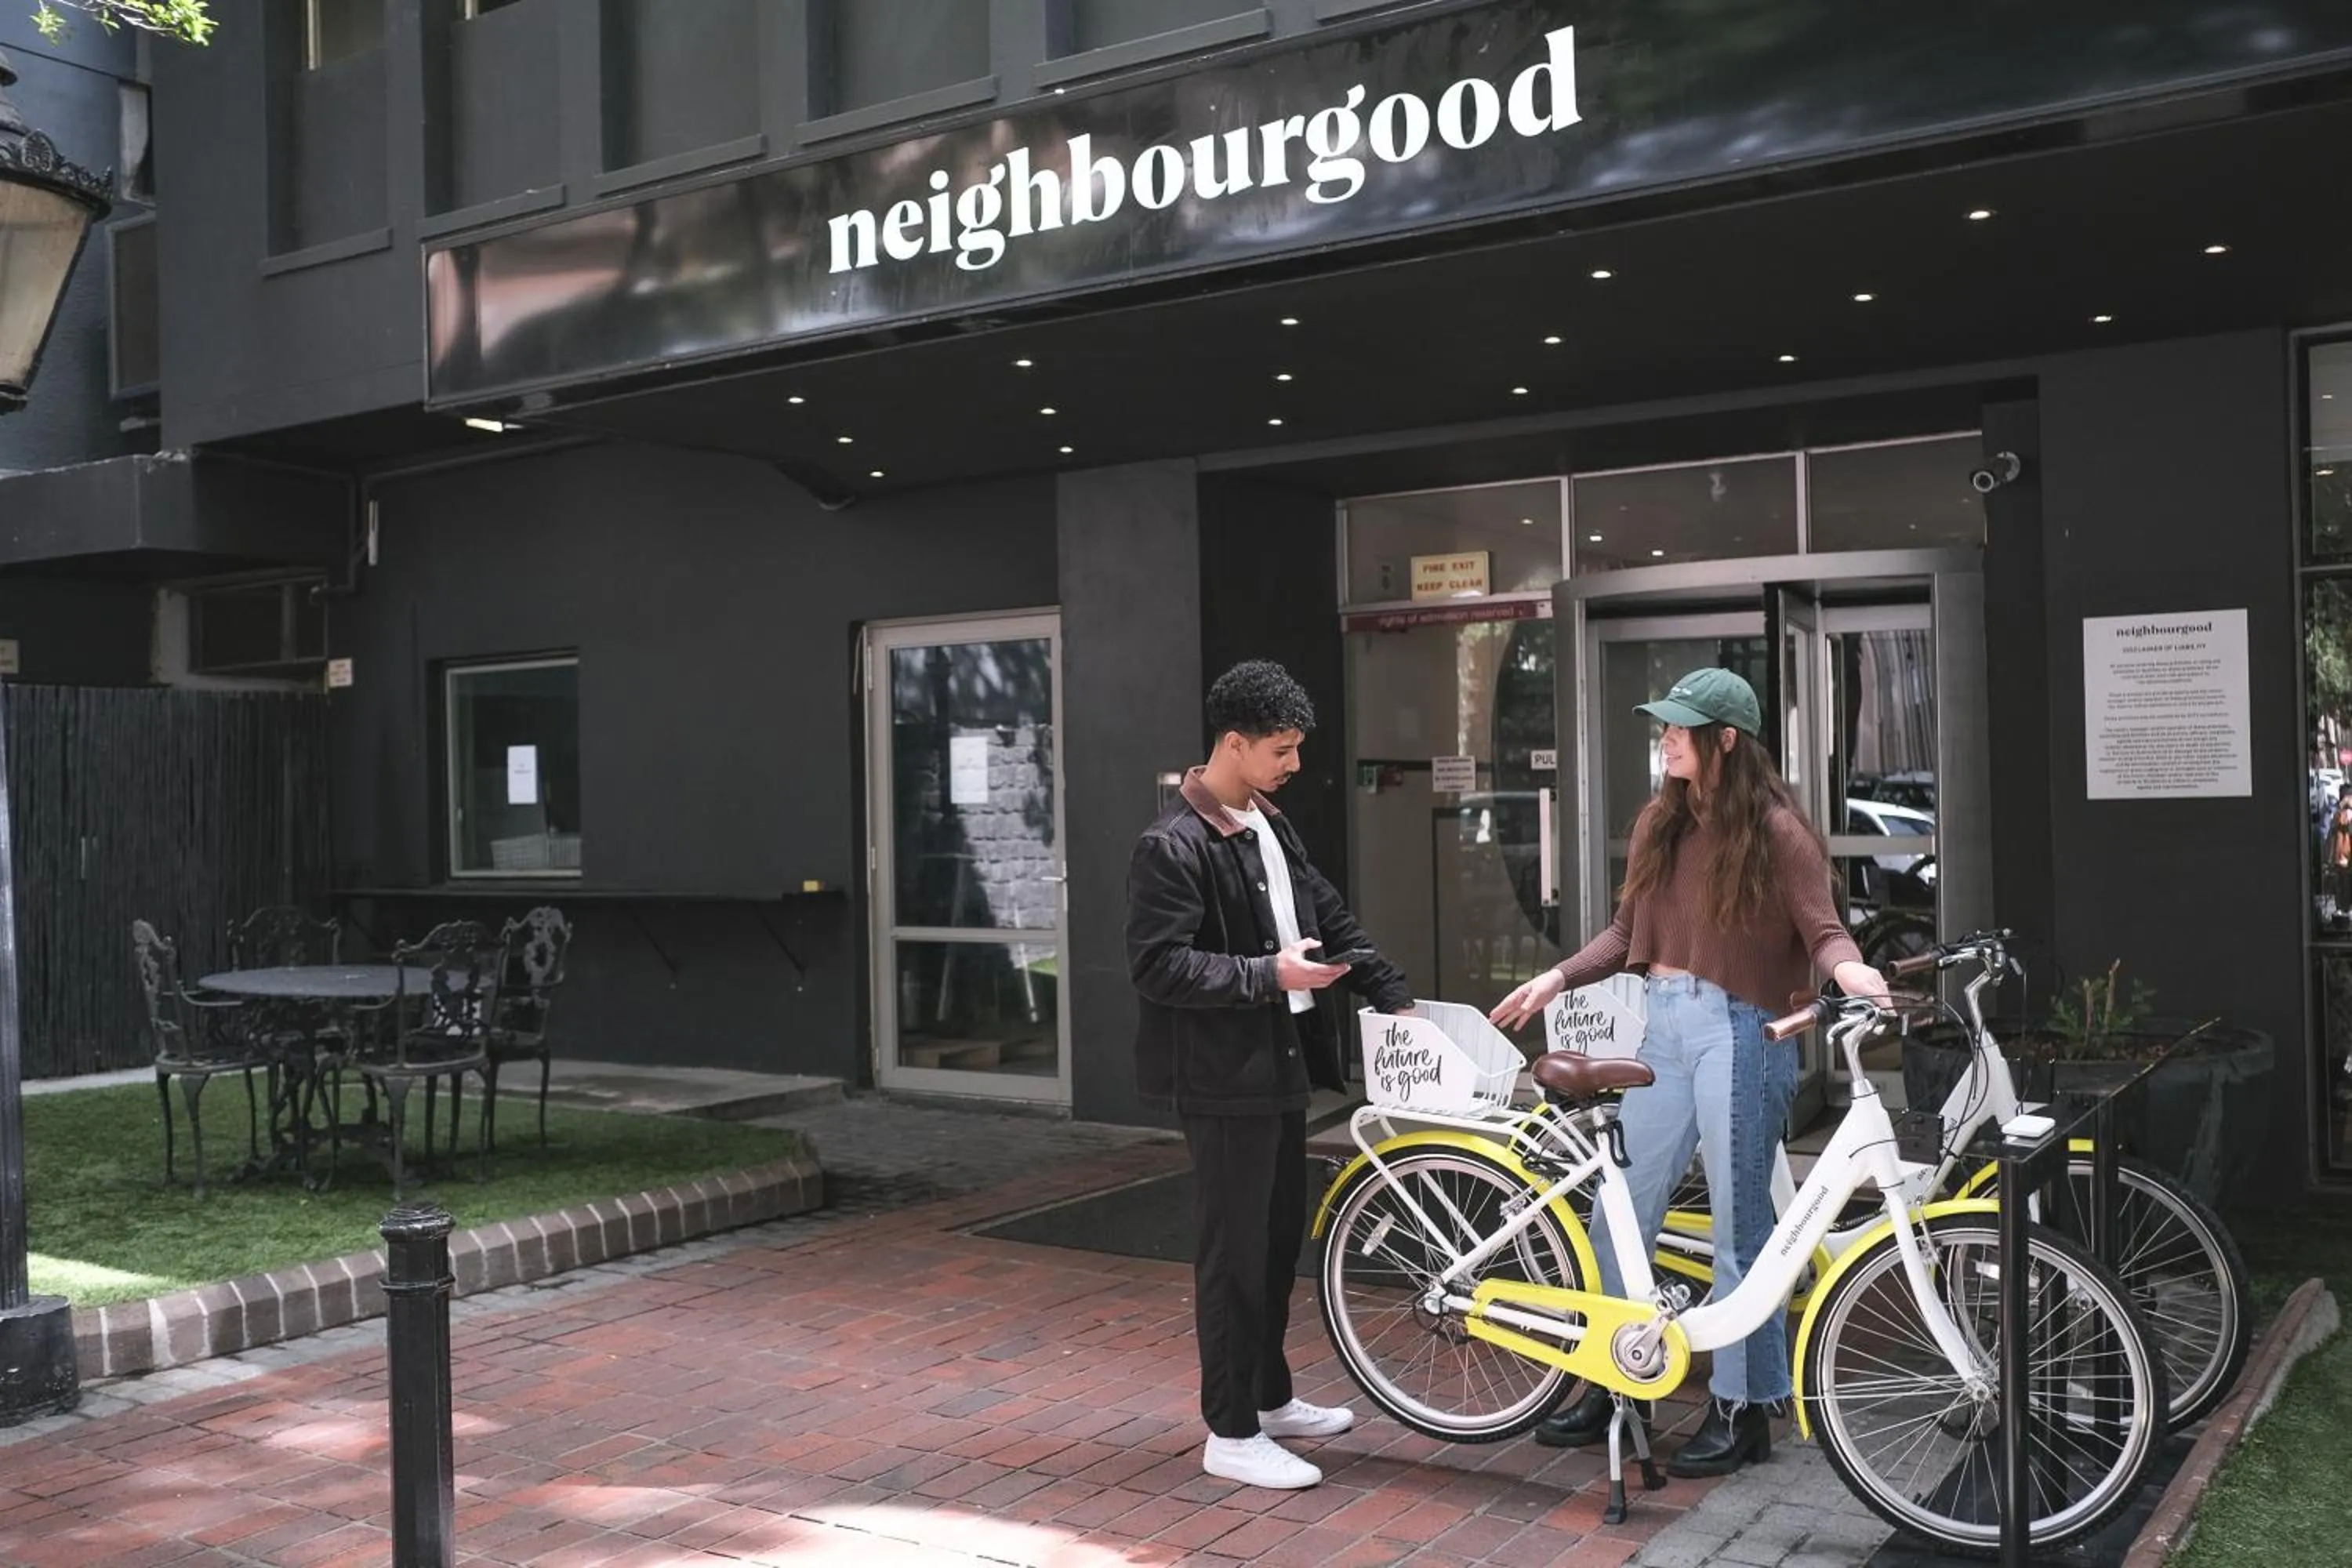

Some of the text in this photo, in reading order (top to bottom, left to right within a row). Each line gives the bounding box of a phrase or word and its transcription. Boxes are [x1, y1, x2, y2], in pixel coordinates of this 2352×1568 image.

[828, 25, 1581, 274] neighbourgood
[1422, 560, 1475, 574] FIRE EXIT
[1417, 578, 1483, 591] KEEP CLEAR
[2116, 621, 2212, 638] neighbourgood
[1563, 989, 1589, 1011] the
[1379, 1022, 1413, 1047] the
[1555, 1009, 1606, 1036] future
[1561, 1015, 1615, 1056] is good
[1374, 1046, 1433, 1076] future
[1381, 1054, 1442, 1102] is good
[1780, 1185, 1829, 1256] neighbourgood
